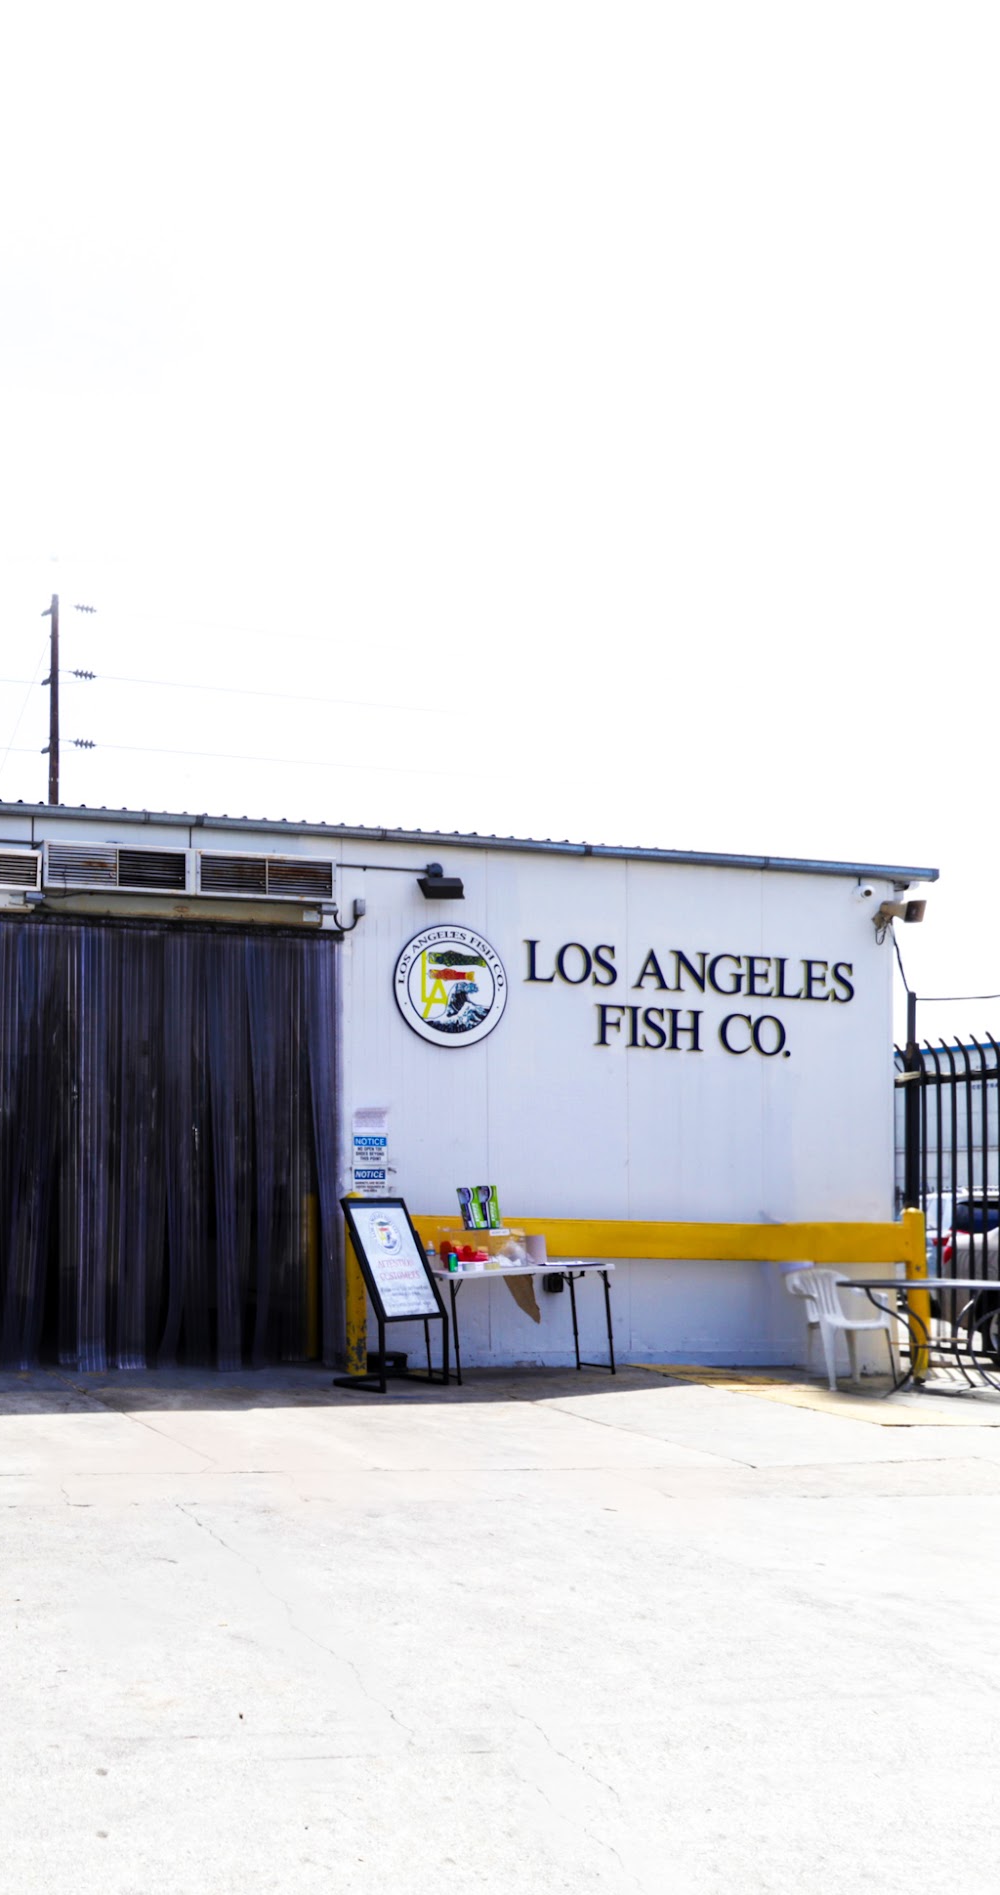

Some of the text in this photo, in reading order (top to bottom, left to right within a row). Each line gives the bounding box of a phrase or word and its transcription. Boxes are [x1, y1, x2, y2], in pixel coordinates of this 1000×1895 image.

[398, 954, 411, 984] LOS
[411, 931, 467, 953] ANGELES
[469, 936, 495, 961] FISH
[523, 939, 855, 1003] LOS ANGELES
[594, 1003, 791, 1058] FISH CO.
[355, 1137, 384, 1146] NOTICE
[355, 1170, 384, 1179] NOTICE
